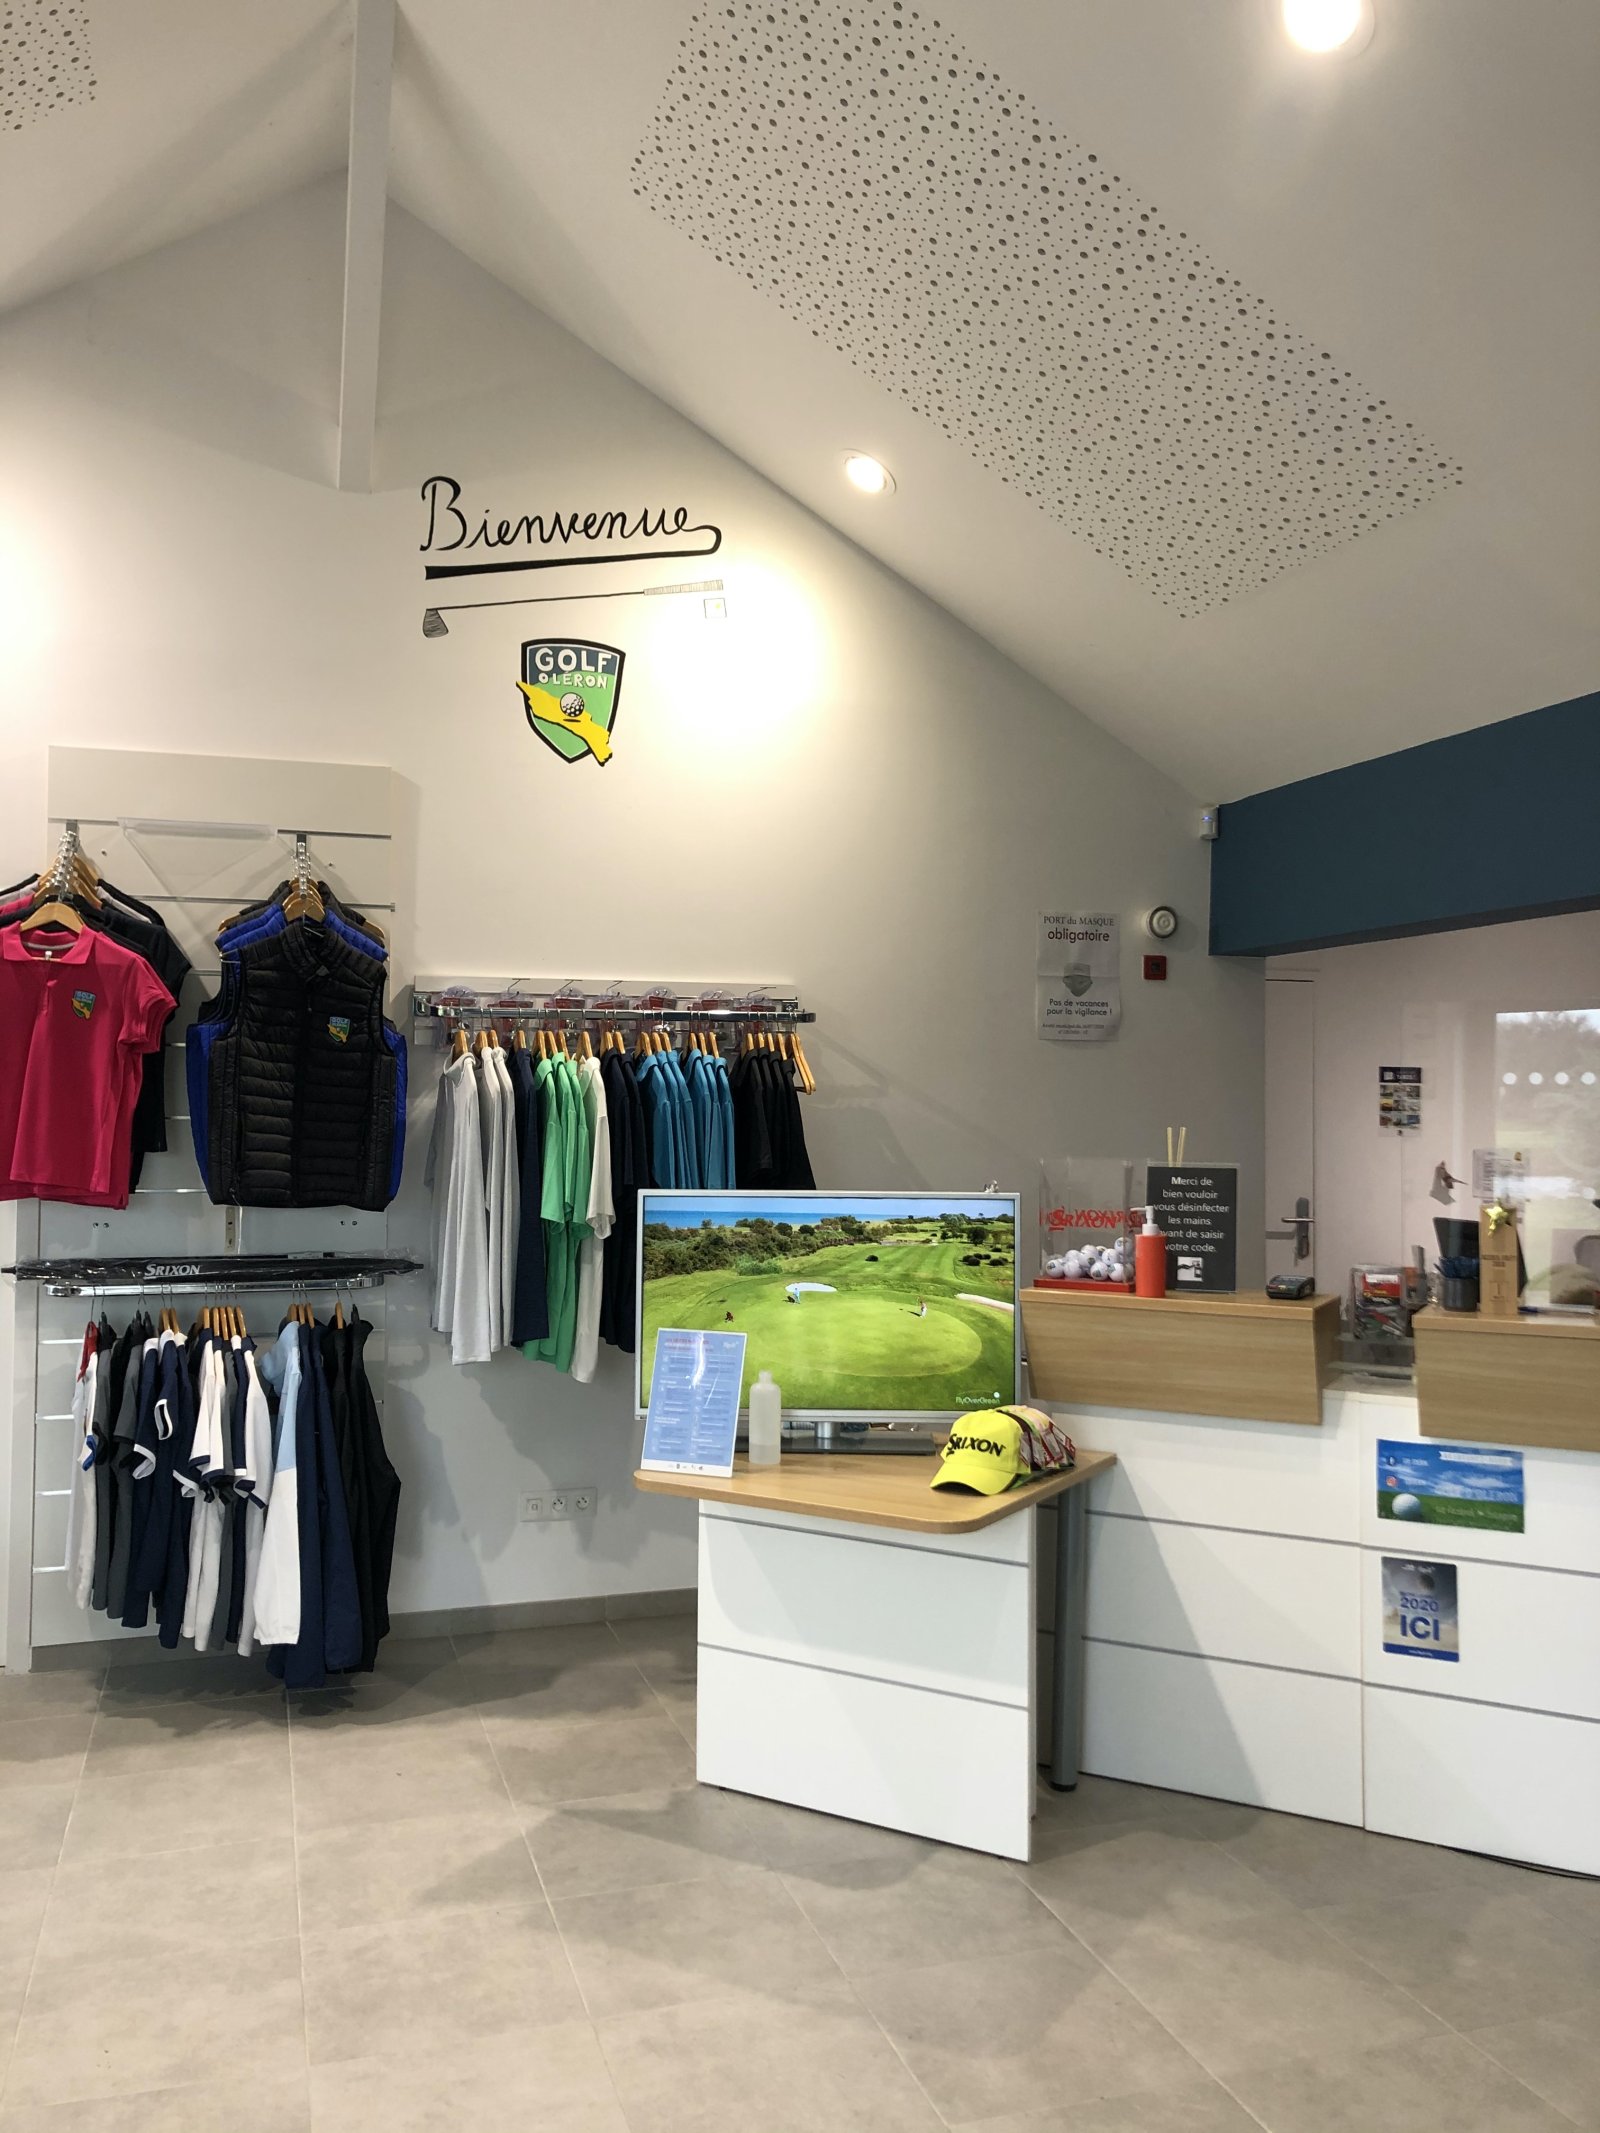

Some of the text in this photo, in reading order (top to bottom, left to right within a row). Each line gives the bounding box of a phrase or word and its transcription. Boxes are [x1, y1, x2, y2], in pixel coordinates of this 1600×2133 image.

[419, 475, 722, 553] Bienvenue
[535, 647, 612, 673] GOLF
[1043, 916, 1115, 927] PORT du MASQUE
[1047, 927, 1110, 944] obligatoire
[1049, 998, 1109, 1008] Pas de vacances
[1046, 1008, 1063, 1016] pour
[1075, 1008, 1107, 1017] vigilance
[1171, 1176, 1213, 1186] Merci de
[1162, 1189, 1219, 1199] bien vouloir
[1153, 1202, 1230, 1213] vous désinfecter
[1168, 1215, 1212, 1225] les mains
[1185, 1229, 1199, 1238] de
[1200, 1229, 1225, 1239] saisir
[1164, 1243, 1217, 1252] votre code.
[143, 1264, 201, 1280] SRIXON
[955, 1396, 1000, 1405] FlyOverGreen
[945, 1432, 1006, 1458] SRIXON
[1400, 1596, 1440, 1613] 2020
[1400, 1613, 1440, 1642] ICI
